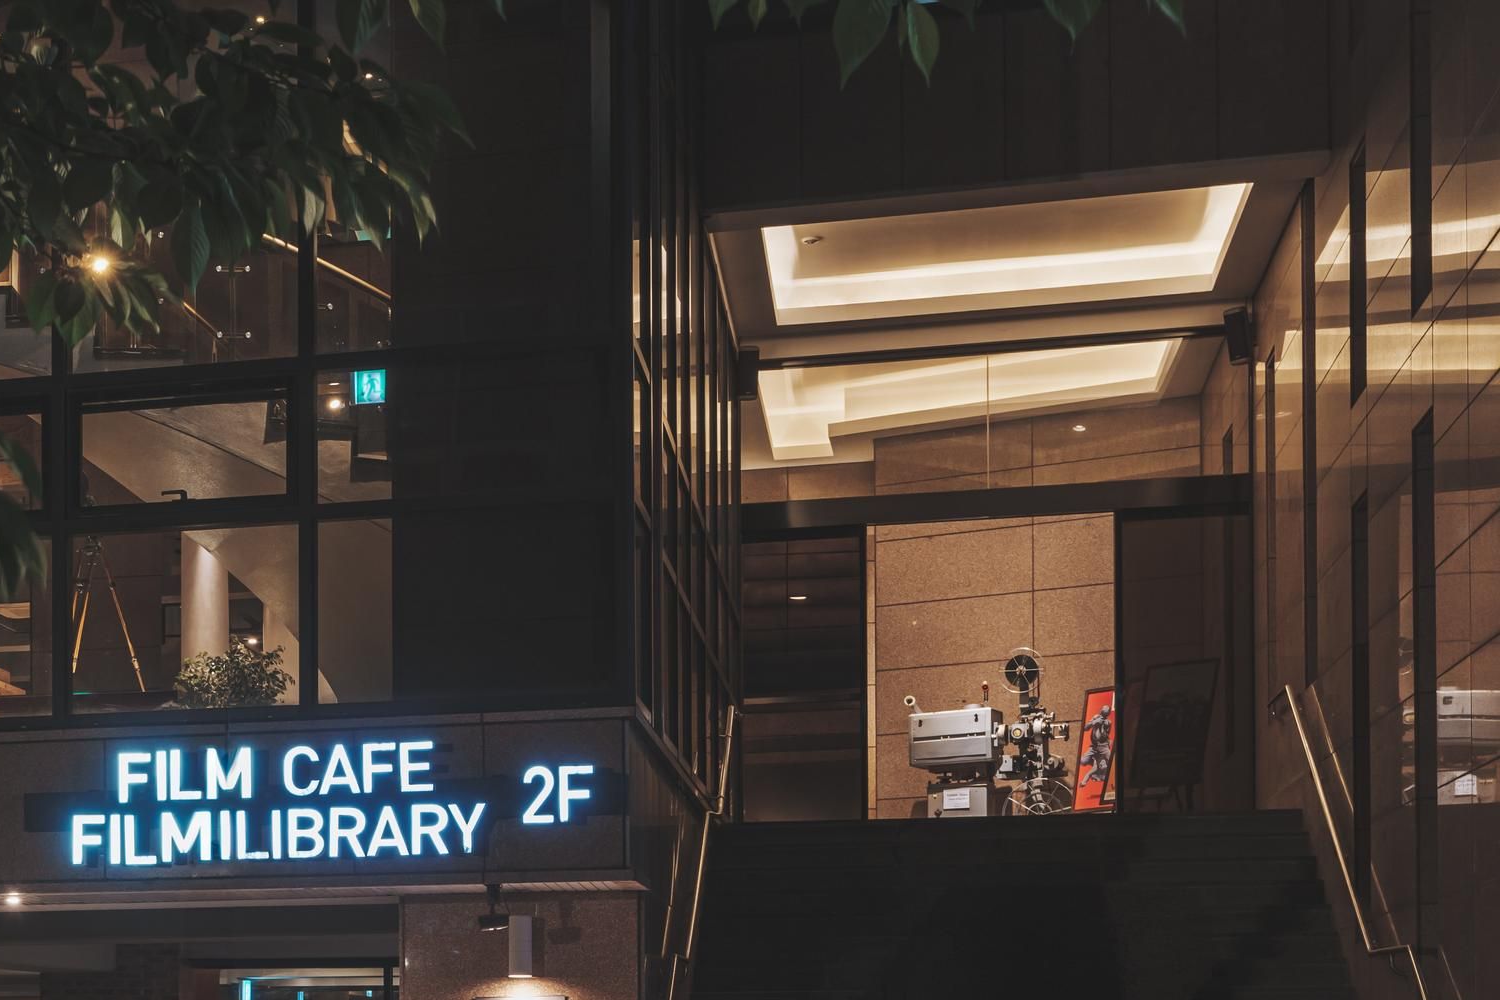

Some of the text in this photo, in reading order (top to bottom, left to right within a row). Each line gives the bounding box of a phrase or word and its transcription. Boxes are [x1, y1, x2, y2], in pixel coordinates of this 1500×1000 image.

[118, 740, 434, 803] FILM CAFE
[522, 764, 594, 824] 2F
